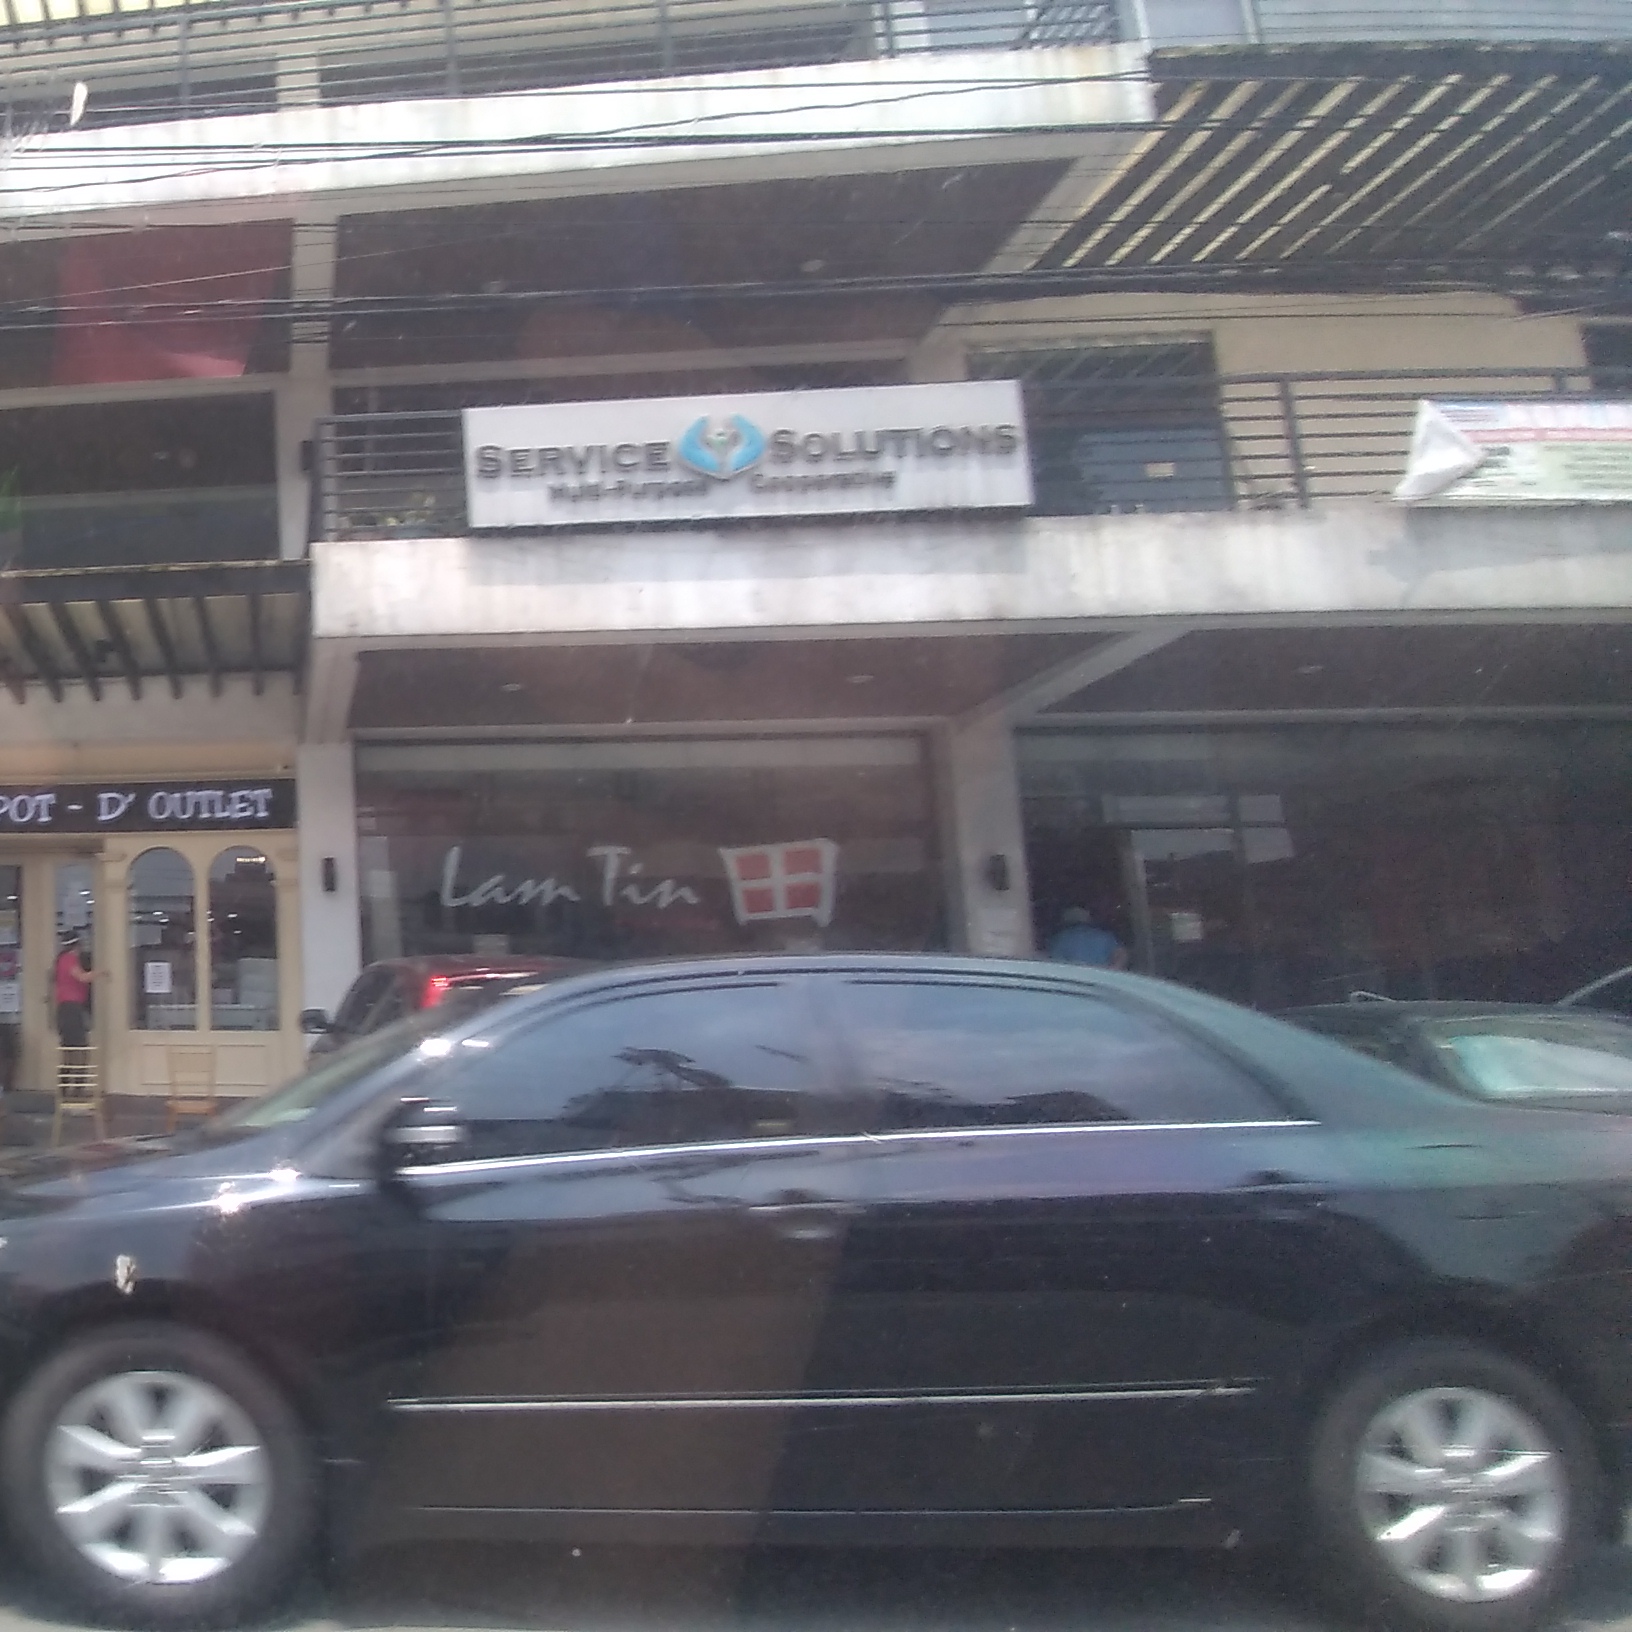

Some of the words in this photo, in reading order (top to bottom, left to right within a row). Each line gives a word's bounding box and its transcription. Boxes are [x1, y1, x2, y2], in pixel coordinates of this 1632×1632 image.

[475, 440, 672, 479] SERVICE
[767, 424, 1018, 464] SOLUTIONS
[147, 787, 275, 821] OUTLET
[440, 846, 581, 908] Lam
[585, 846, 699, 906] Tin
